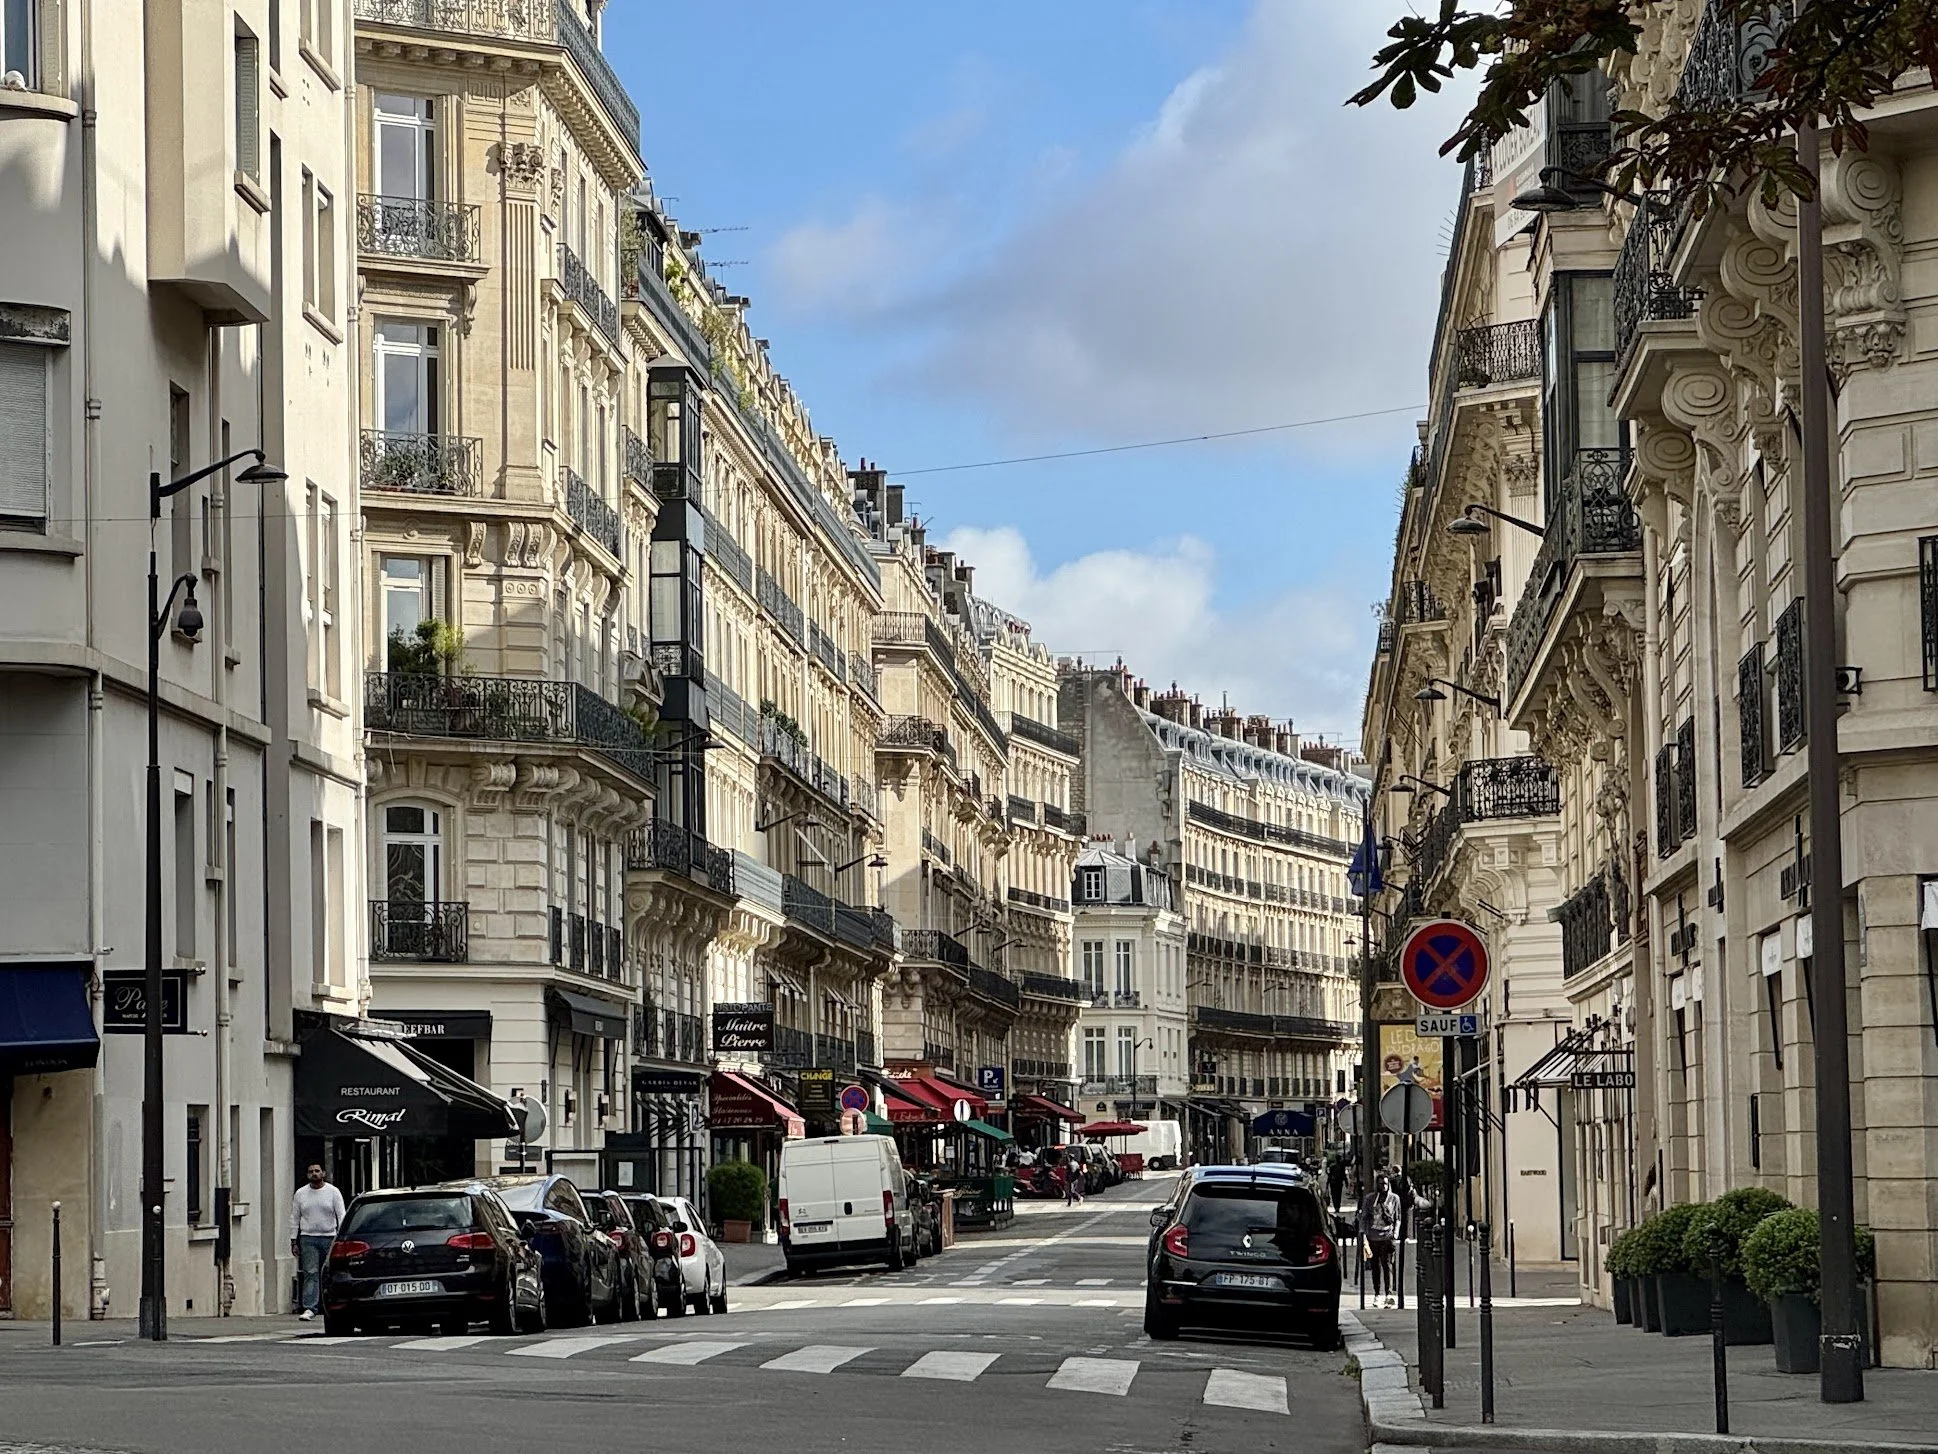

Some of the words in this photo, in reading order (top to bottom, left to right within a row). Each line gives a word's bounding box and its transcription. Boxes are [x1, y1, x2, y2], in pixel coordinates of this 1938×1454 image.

[403, 1024, 445, 1035] EEFBAR
[717, 1018, 768, 1031] Maître
[1420, 1019, 1457, 1032] SAUF
[720, 1034, 767, 1047] Pierre
[800, 1072, 832, 1080] CHANGE
[984, 1070, 993, 1083] P
[1574, 1075, 1592, 1086] LE
[1596, 1074, 1634, 1086] LABO
[341, 1087, 400, 1096] RESTAURANT
[336, 1108, 407, 1130] Rimal
[1268, 1128, 1298, 1136] ANNA
